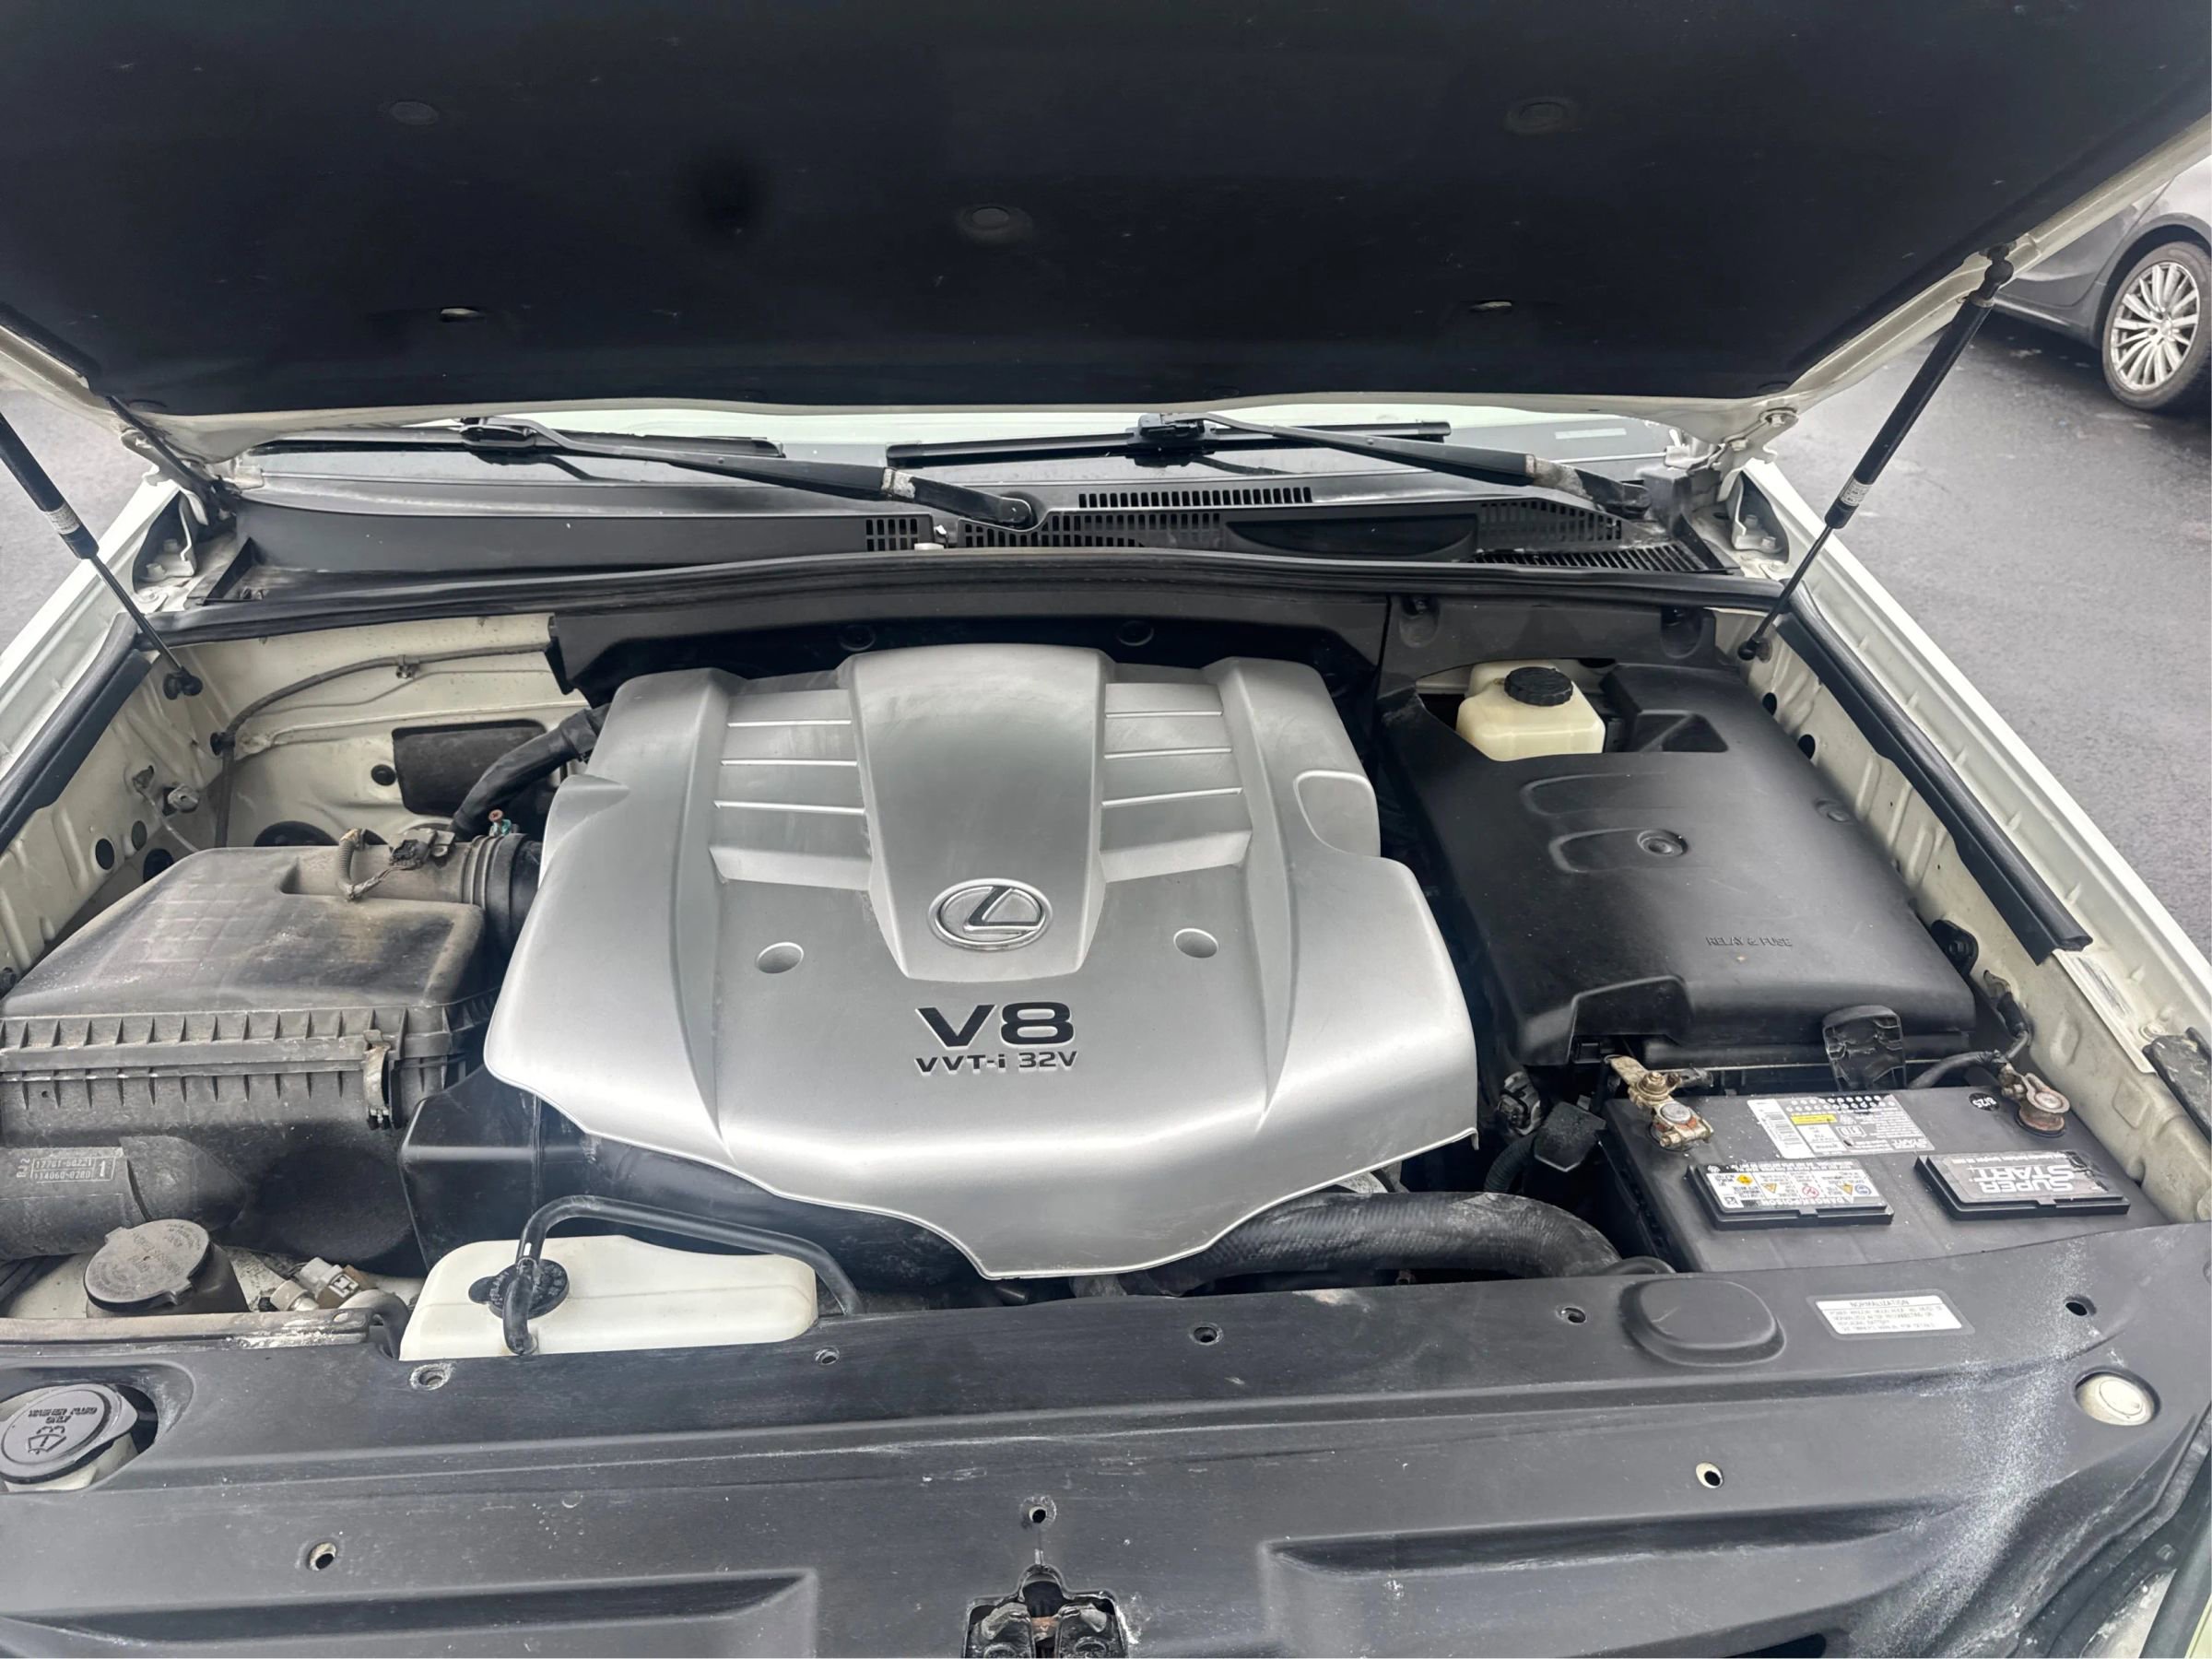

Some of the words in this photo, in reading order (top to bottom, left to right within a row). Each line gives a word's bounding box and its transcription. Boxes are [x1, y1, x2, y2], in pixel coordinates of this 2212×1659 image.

[1705, 936, 1743, 947] RELAY
[1747, 936, 1759, 947] &
[1759, 936, 1794, 947] FUSE
[916, 1001, 1076, 1049] V8
[916, 1053, 1006, 1076] VVT-i
[1018, 1051, 1077, 1071] 32V
[1974, 1164, 2076, 1182] START
[1979, 1178, 2074, 1194] SUPER
